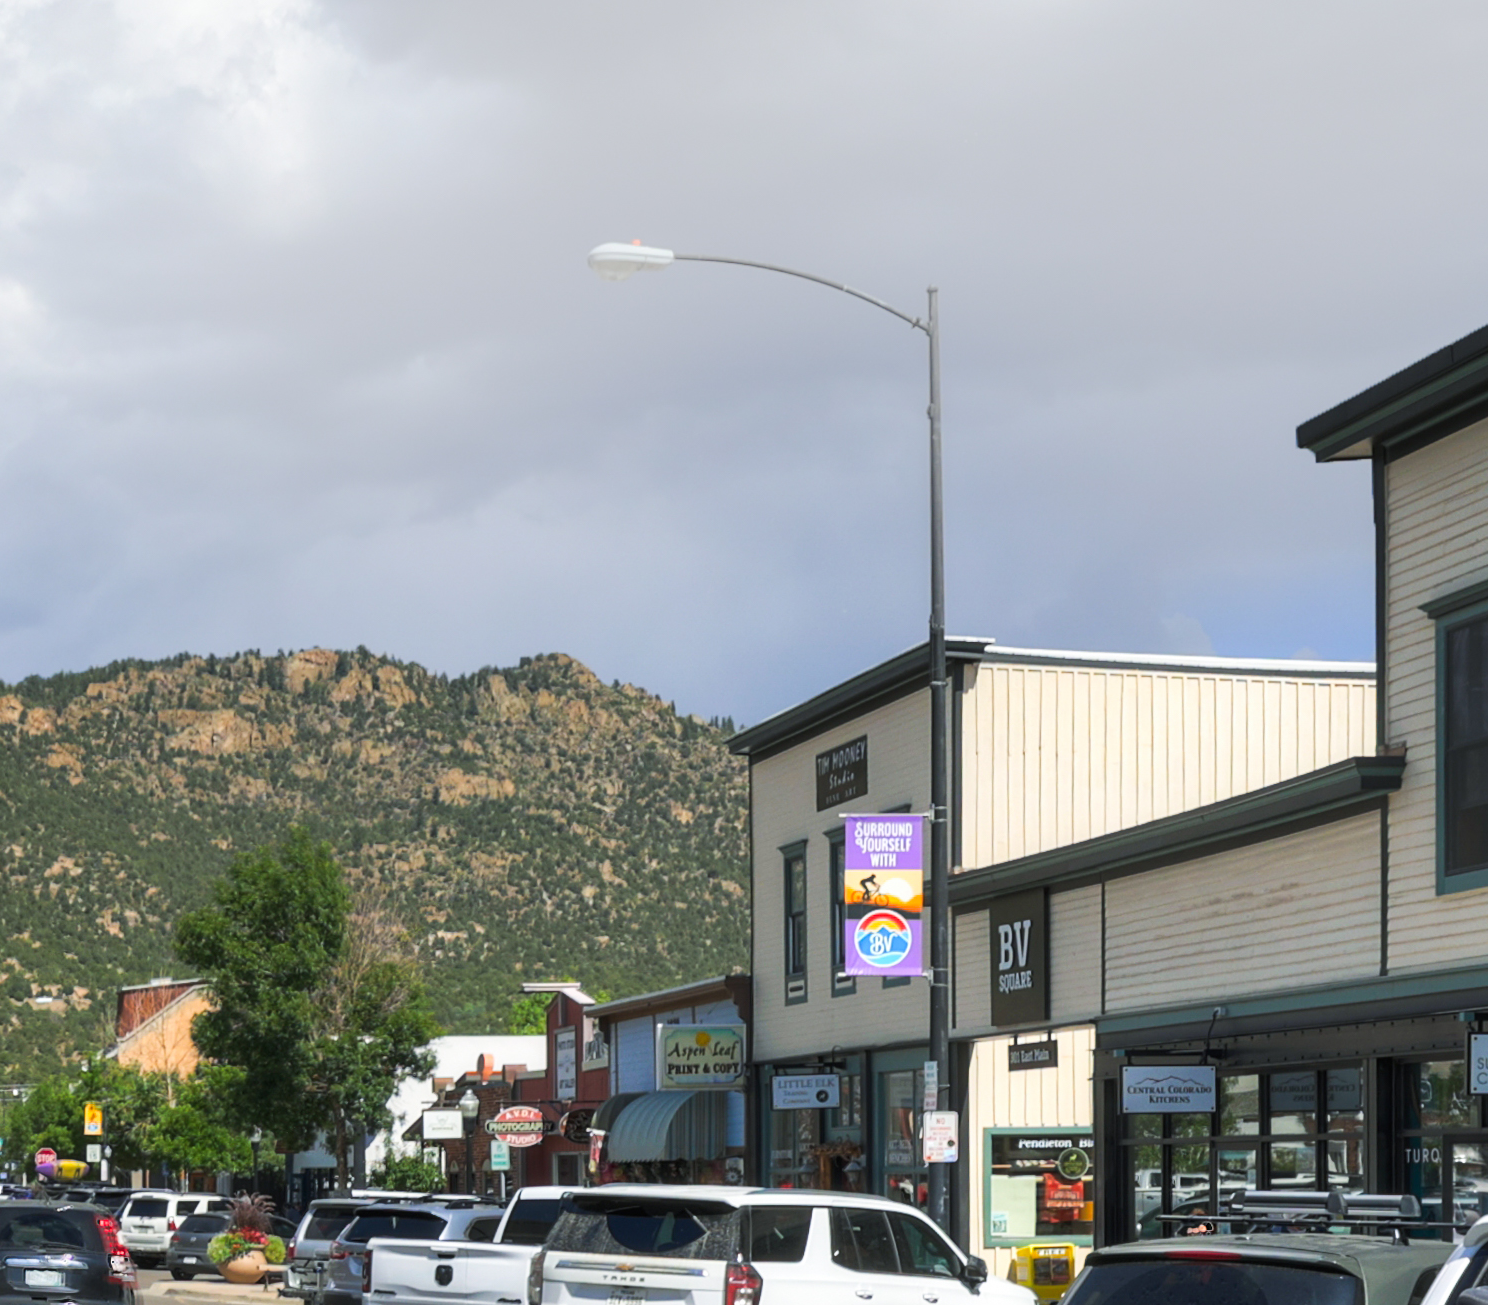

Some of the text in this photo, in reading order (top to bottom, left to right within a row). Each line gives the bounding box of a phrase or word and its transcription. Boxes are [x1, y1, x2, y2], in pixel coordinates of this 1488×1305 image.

[832, 740, 865, 770] MOONEY
[854, 822, 913, 837] SURROUND
[855, 837, 911, 853] YOURSELF
[870, 853, 897, 867] WITH
[869, 933, 898, 955] BV
[998, 919, 1032, 971] BV
[999, 970, 1032, 994] SQUARE
[667, 1040, 739, 1060] Aspen Leaf
[667, 1063, 739, 1074] PRINT & COPY
[778, 1078, 835, 1089] LITTLE ELK
[1127, 1085, 1212, 1094] CENTRAL COLORADO
[1149, 1096, 1190, 1104] KITCHENS
[506, 1133, 536, 1144] STUDIO
[1018, 1139, 1072, 1149] Pendleton
[602, 1275, 646, 1283] TAHOE
